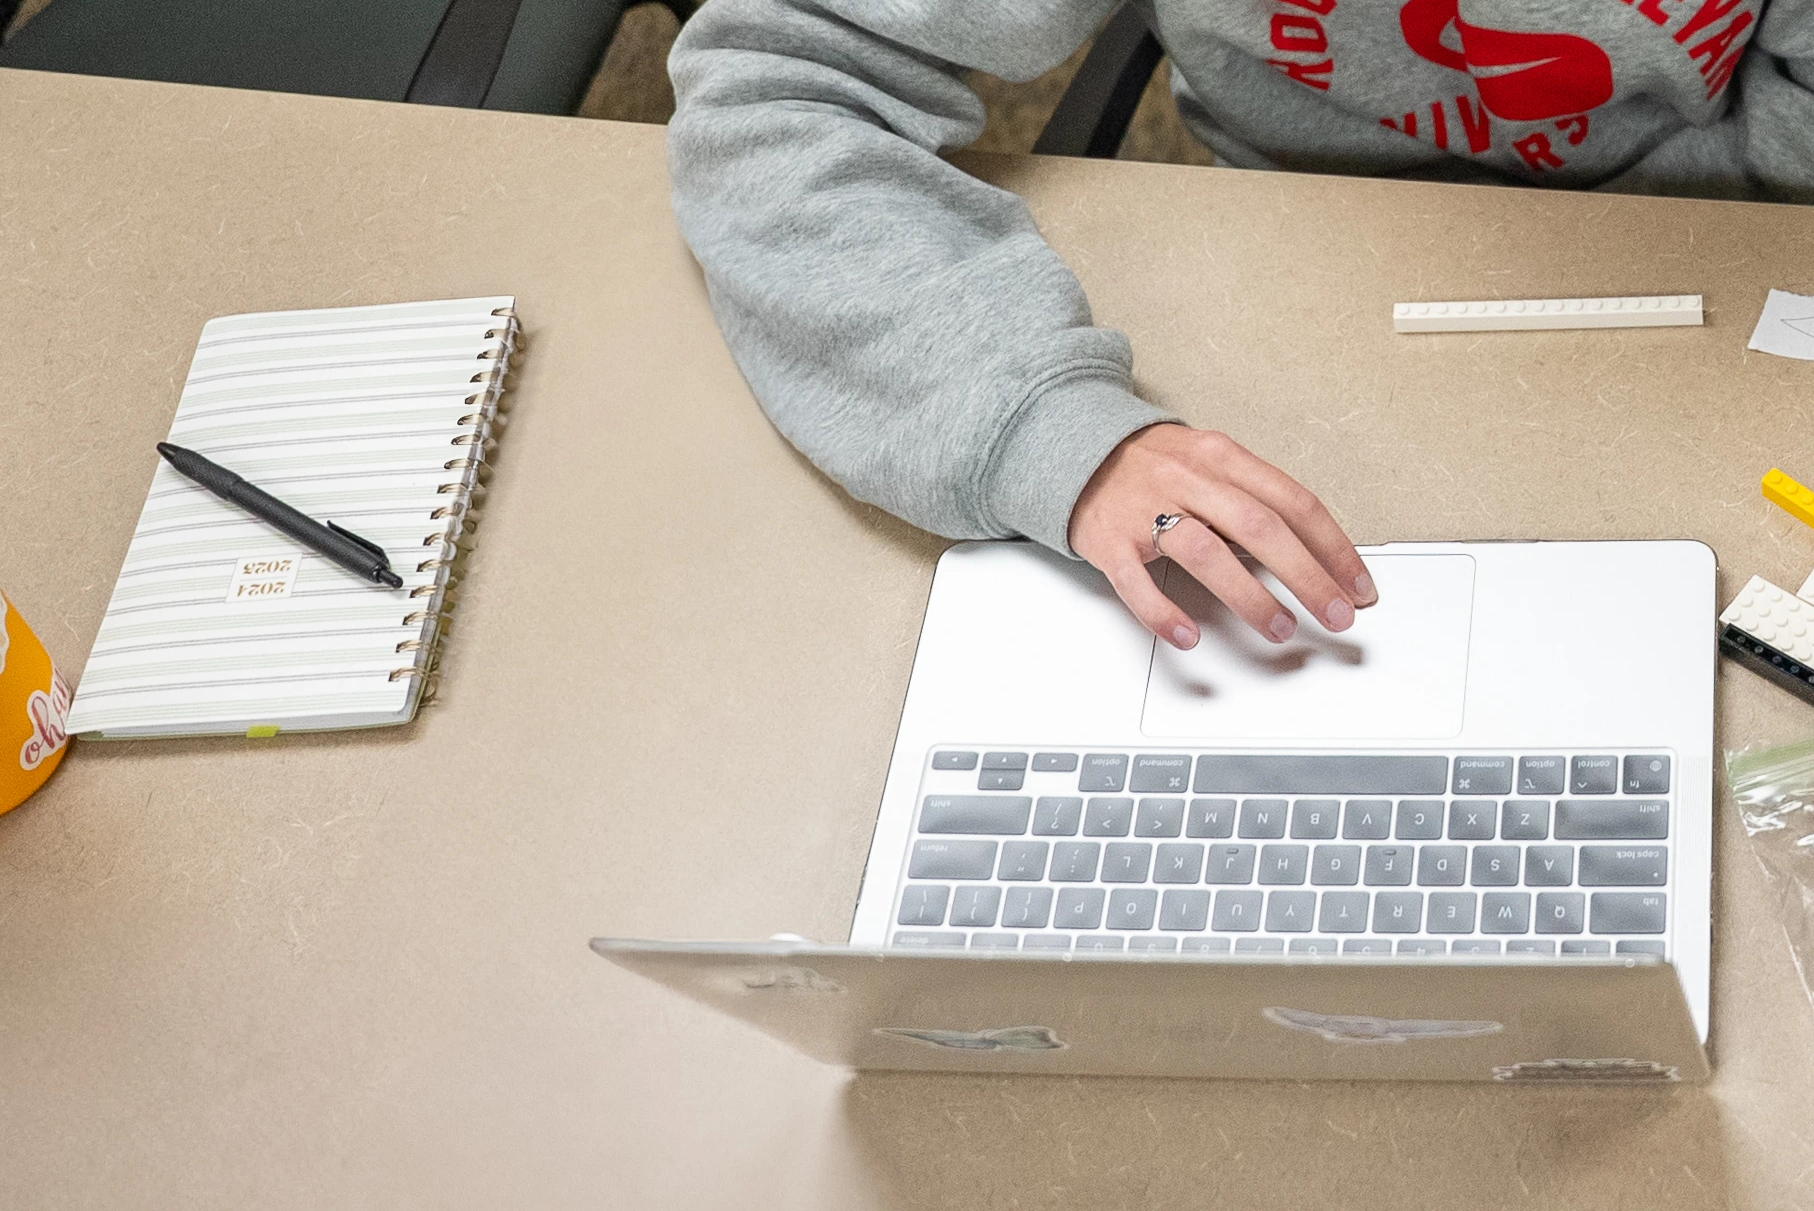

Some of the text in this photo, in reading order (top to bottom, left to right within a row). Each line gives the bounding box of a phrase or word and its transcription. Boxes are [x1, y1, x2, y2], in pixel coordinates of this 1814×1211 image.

[242, 559, 292, 575] 2025
[236, 582, 286, 598] 2024
[1092, 757, 1120, 767] option
[1140, 759, 1183, 767] command
[1460, 760, 1505, 769] command
[1526, 759, 1555, 769] option
[1578, 760, 1610, 769] control
[1630, 780, 1639, 789] fn
[930, 799, 952, 808] shift
[1639, 805, 1660, 813] shift
[1205, 812, 1217, 823] M
[1258, 812, 1268, 823] N
[1310, 813, 1320, 824] B
[1362, 813, 1372, 824] V
[1415, 813, 1424, 824] C
[1467, 813, 1477, 824] X
[1521, 813, 1530, 824] Z
[1616, 849, 1659, 859] caps lock
[1123, 856, 1131, 867] L
[1174, 857, 1183, 868] K
[1226, 857, 1234, 868] J
[1278, 858, 1288, 868] H
[1331, 858, 1341, 870] G
[1385, 858, 1393, 870] F
[1437, 859, 1447, 870] D
[1491, 858, 1500, 870] S
[1544, 859, 1554, 870] A
[1075, 901, 1083, 913] P
[1643, 897, 1659, 906] tab
[1126, 902, 1137, 914] O
[1232, 903, 1242, 915] U
[1285, 905, 1295, 916] Y
[1339, 905, 1348, 917] T
[1394, 905, 1403, 917] R
[1448, 906, 1456, 917] E
[1498, 906, 1513, 917] W
[1555, 905, 1566, 918] Q
[900, 936, 929, 946] delete
